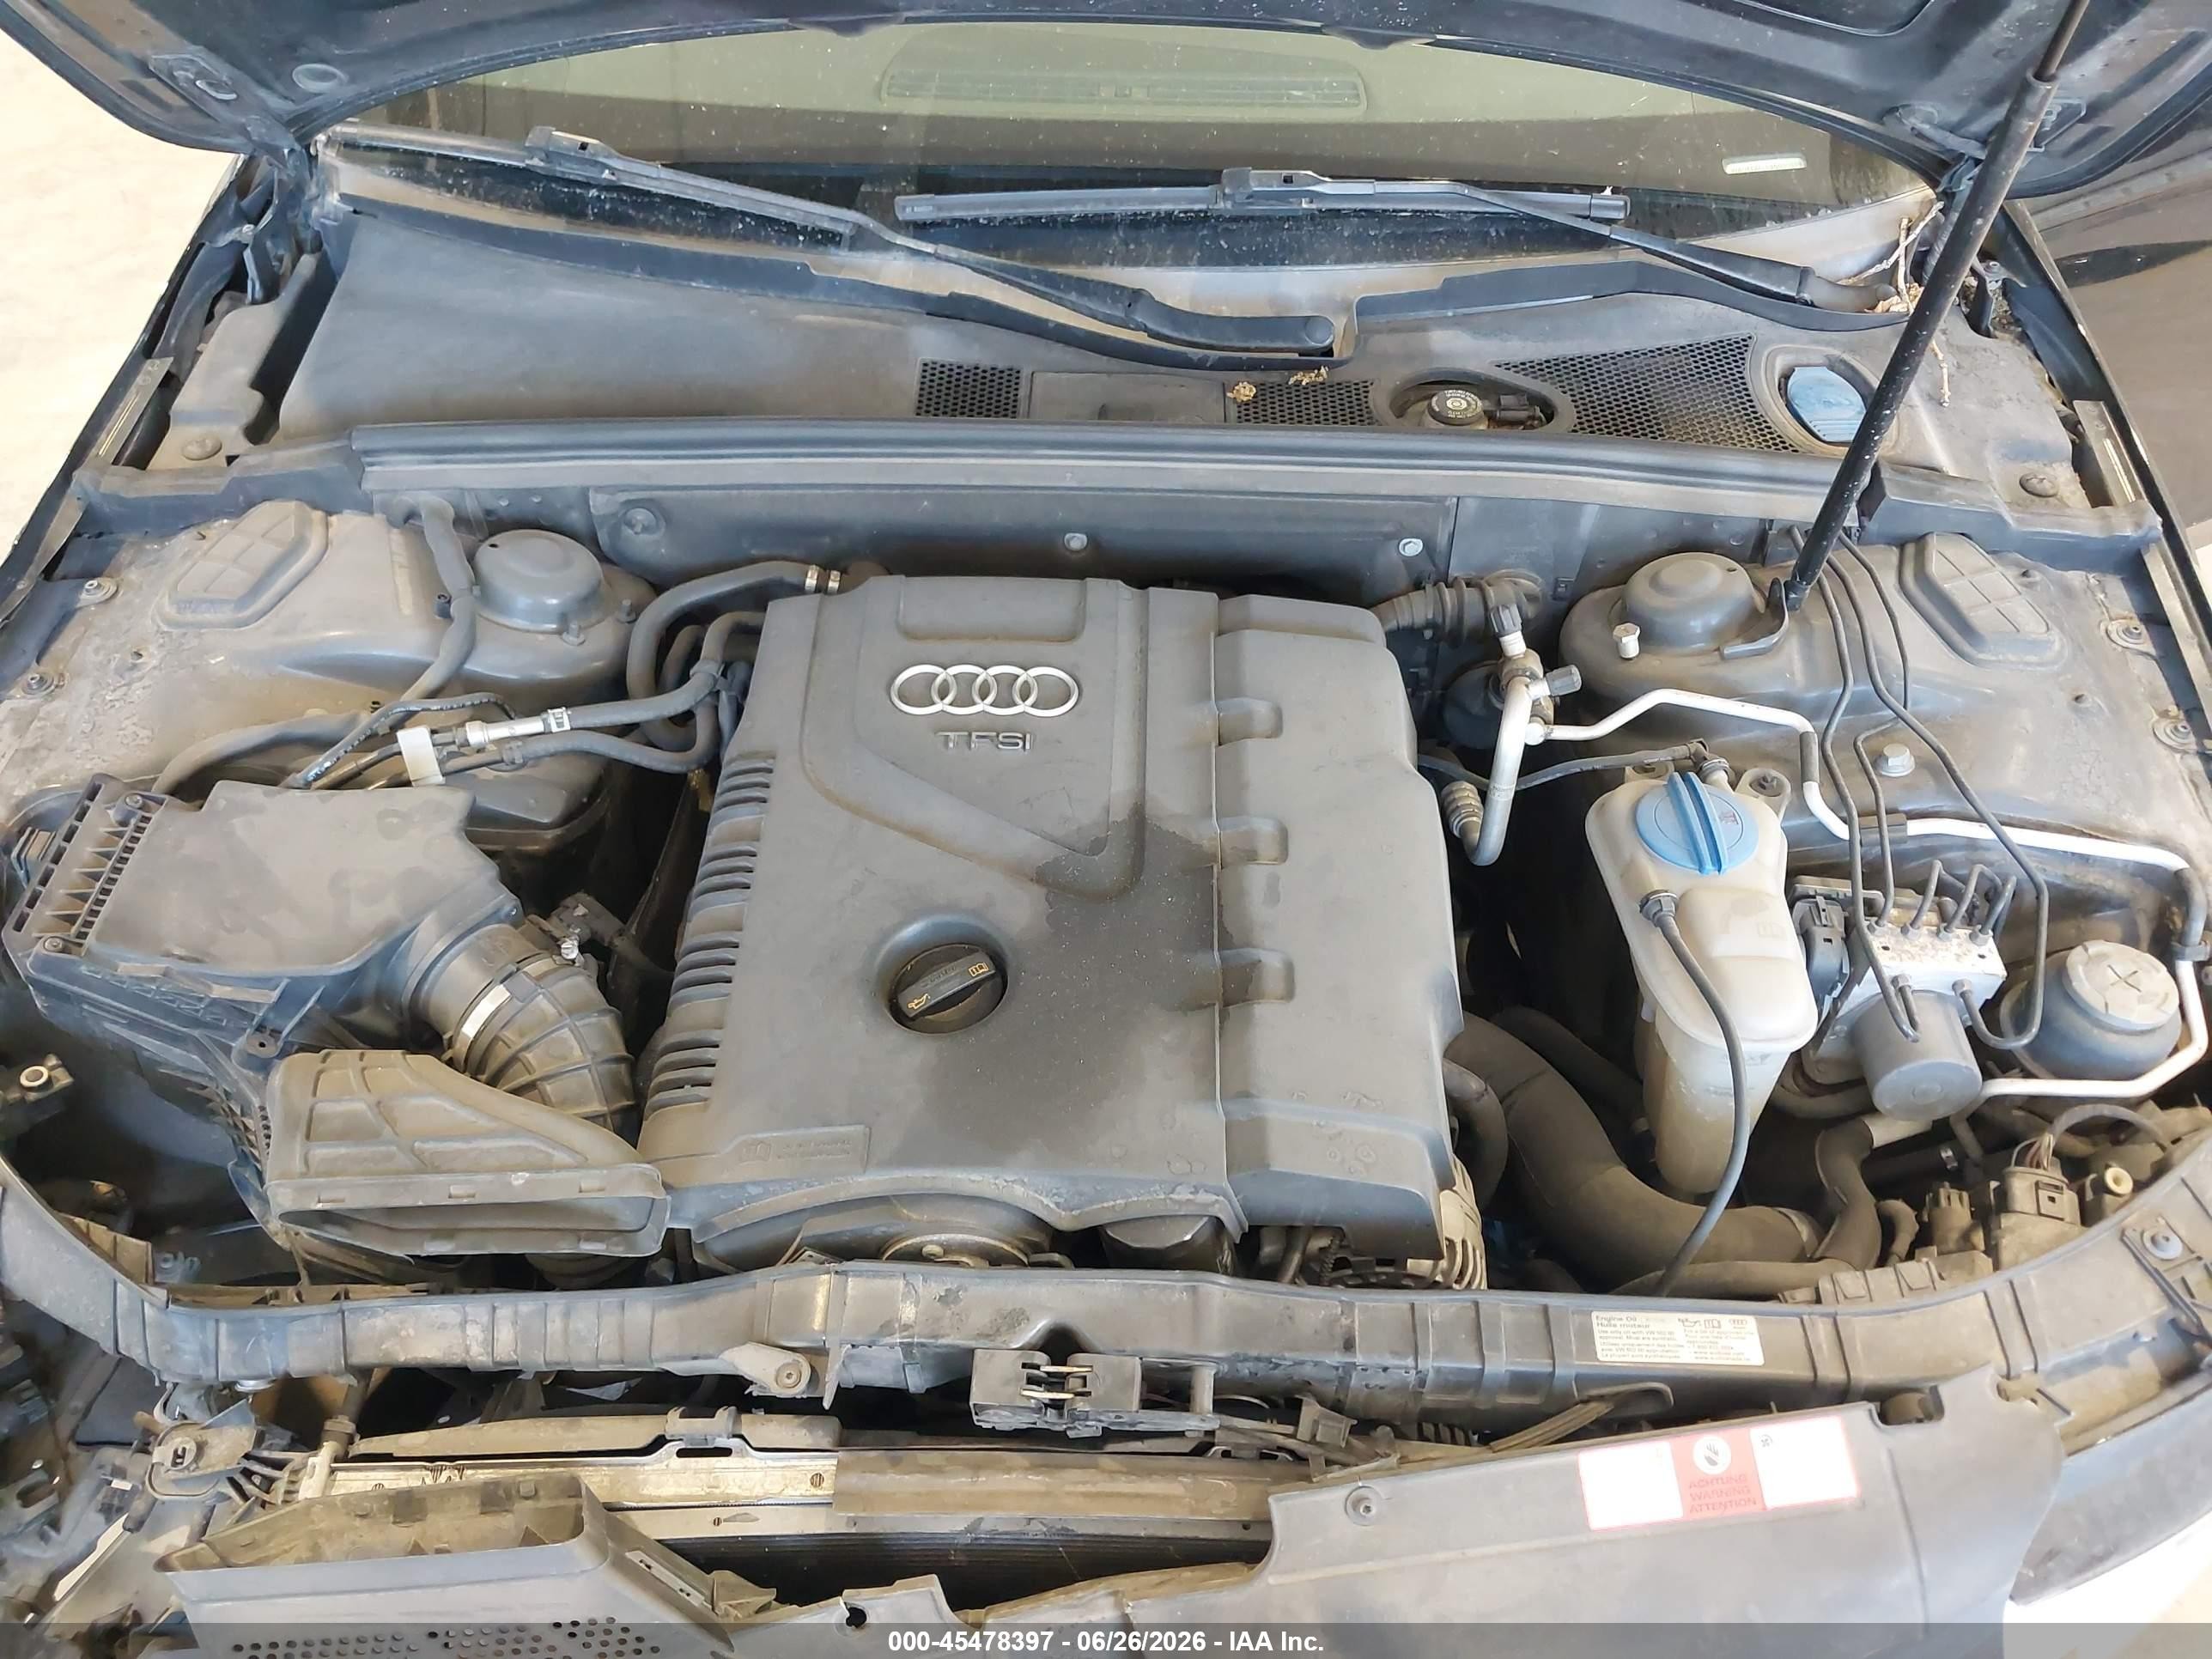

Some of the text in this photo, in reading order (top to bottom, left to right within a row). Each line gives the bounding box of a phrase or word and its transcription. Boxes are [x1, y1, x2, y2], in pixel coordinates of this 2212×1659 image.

[934, 731, 1031, 750] TFSI
[1595, 1315, 1623, 1323] Engine
[1689, 1473, 1747, 1489] ACHTUNG
[1689, 1485, 1752, 1502] WARNING
[1689, 1497, 1758, 1514] ATTENTION
